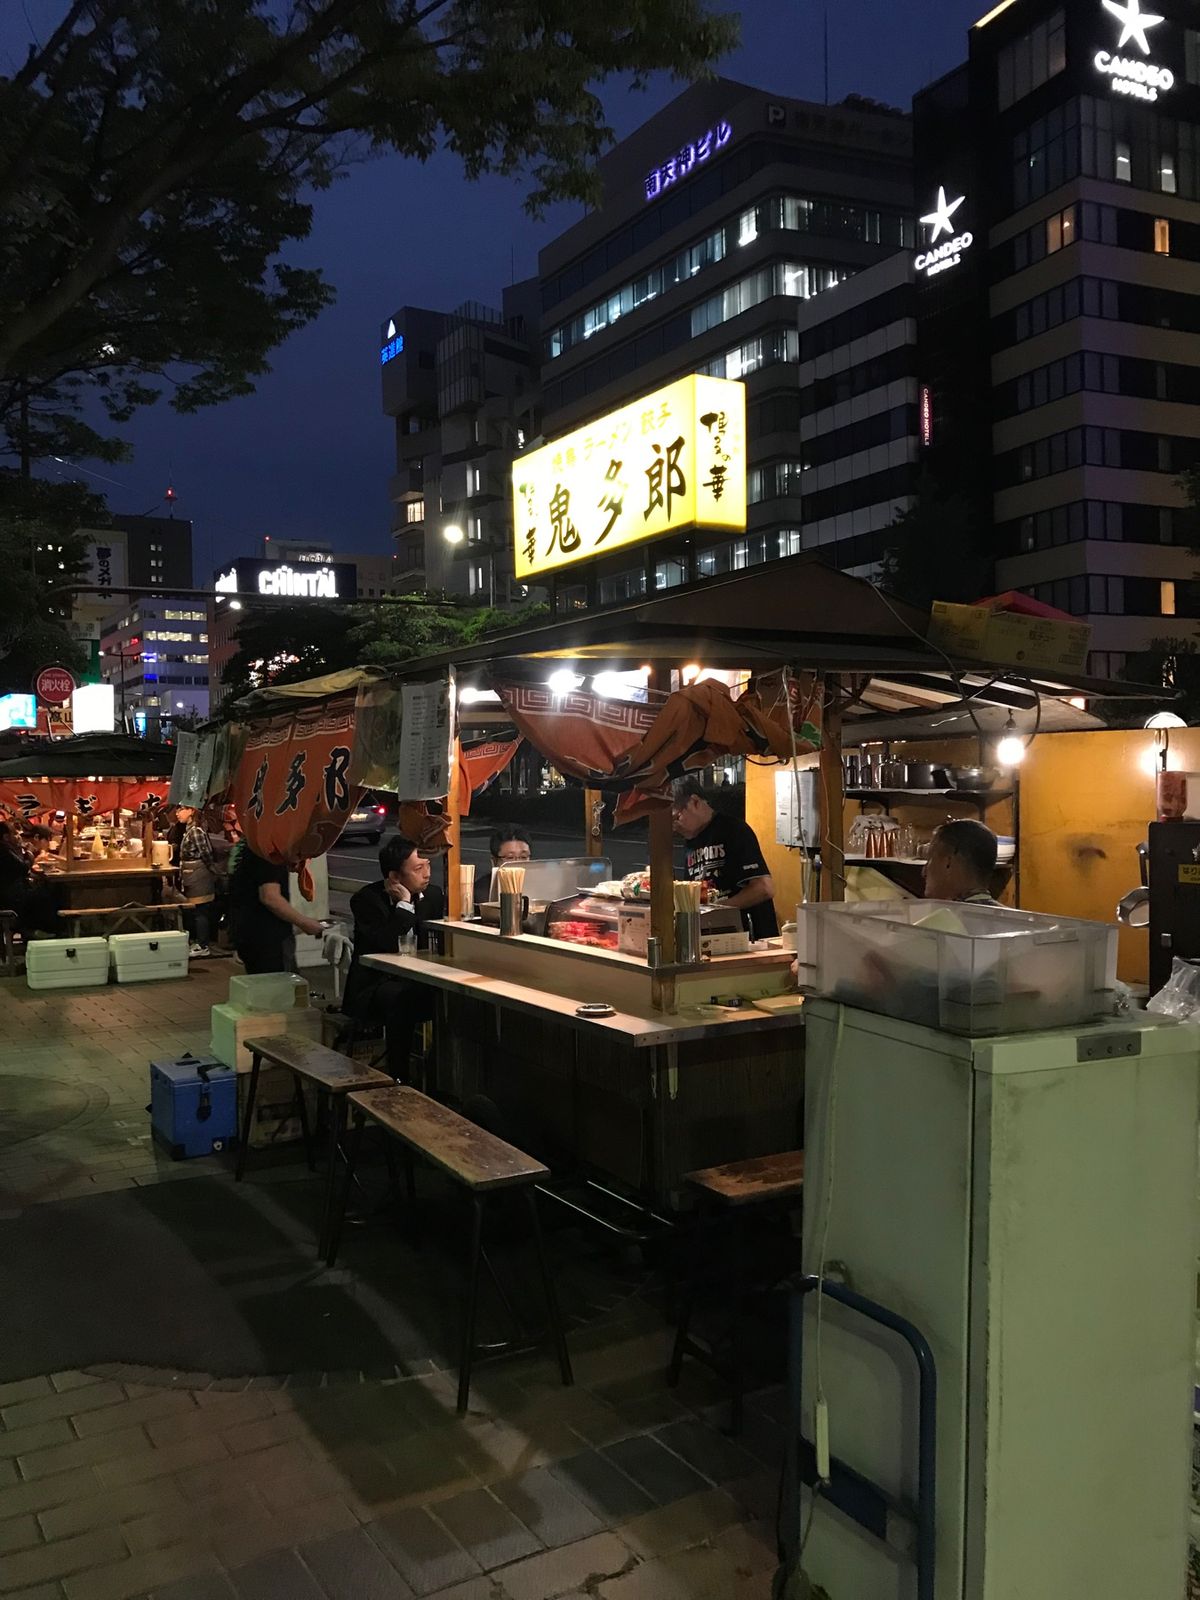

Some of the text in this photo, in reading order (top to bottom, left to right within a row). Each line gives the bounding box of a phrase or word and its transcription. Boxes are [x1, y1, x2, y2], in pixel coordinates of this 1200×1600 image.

[1094, 50, 1174, 90] CANDEO
[1111, 77, 1158, 101] HOTELS
[644, 122, 732, 200] 南天神ビル
[914, 232, 973, 270] CANDEO
[927, 253, 961, 276] HOTELS
[545, 436, 687, 556] 鬼多郎
[41, 679, 71, 692] 消火栓
